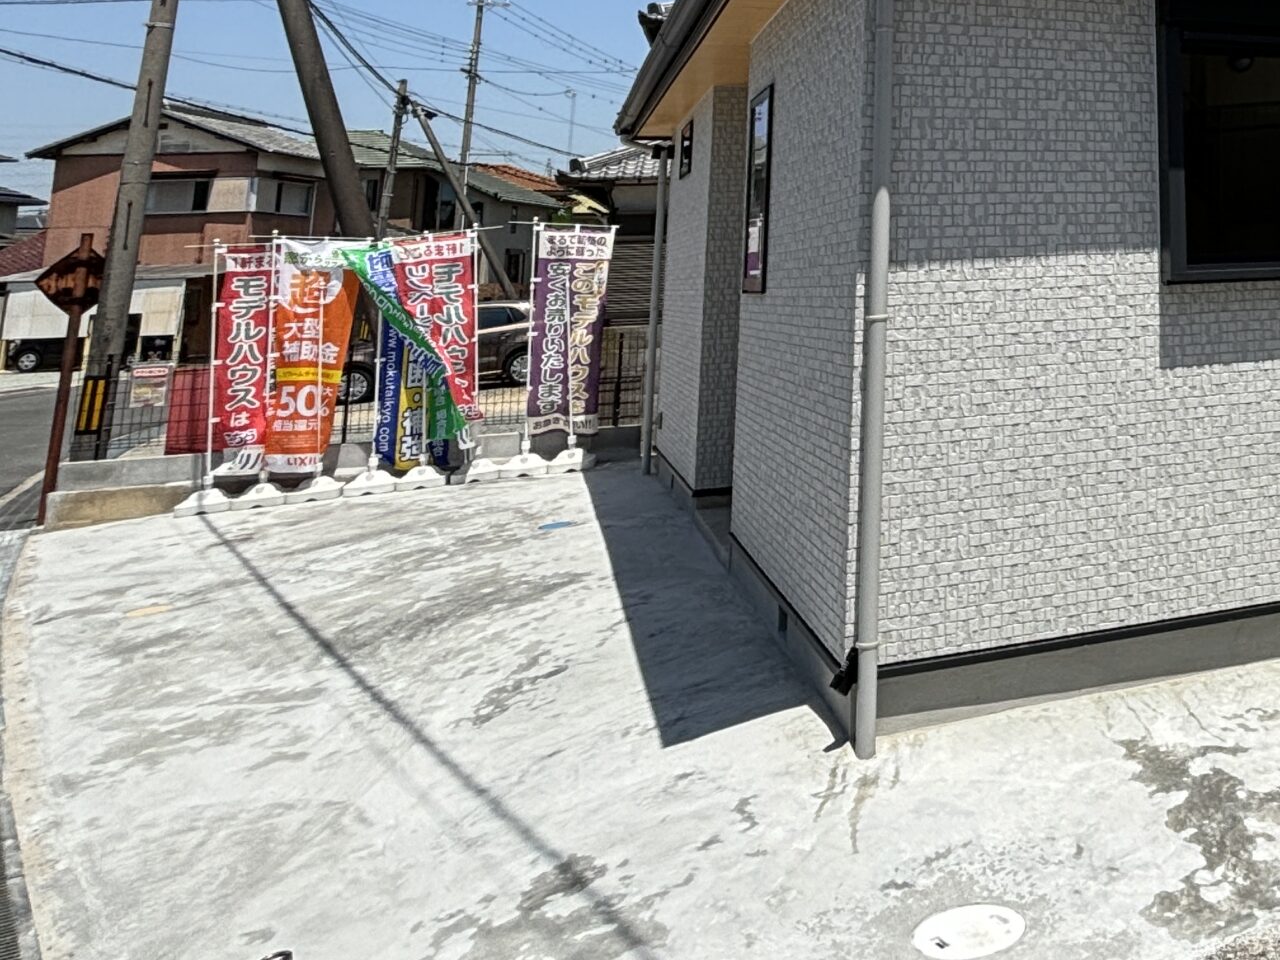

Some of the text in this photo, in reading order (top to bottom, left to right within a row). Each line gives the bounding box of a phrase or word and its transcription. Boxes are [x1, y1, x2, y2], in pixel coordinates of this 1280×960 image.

[224, 275, 267, 427] モデルハウスは
[283, 317, 321, 339] 大型
[283, 339, 341, 364] 補助金
[538, 261, 571, 414] 安くお売りいたします
